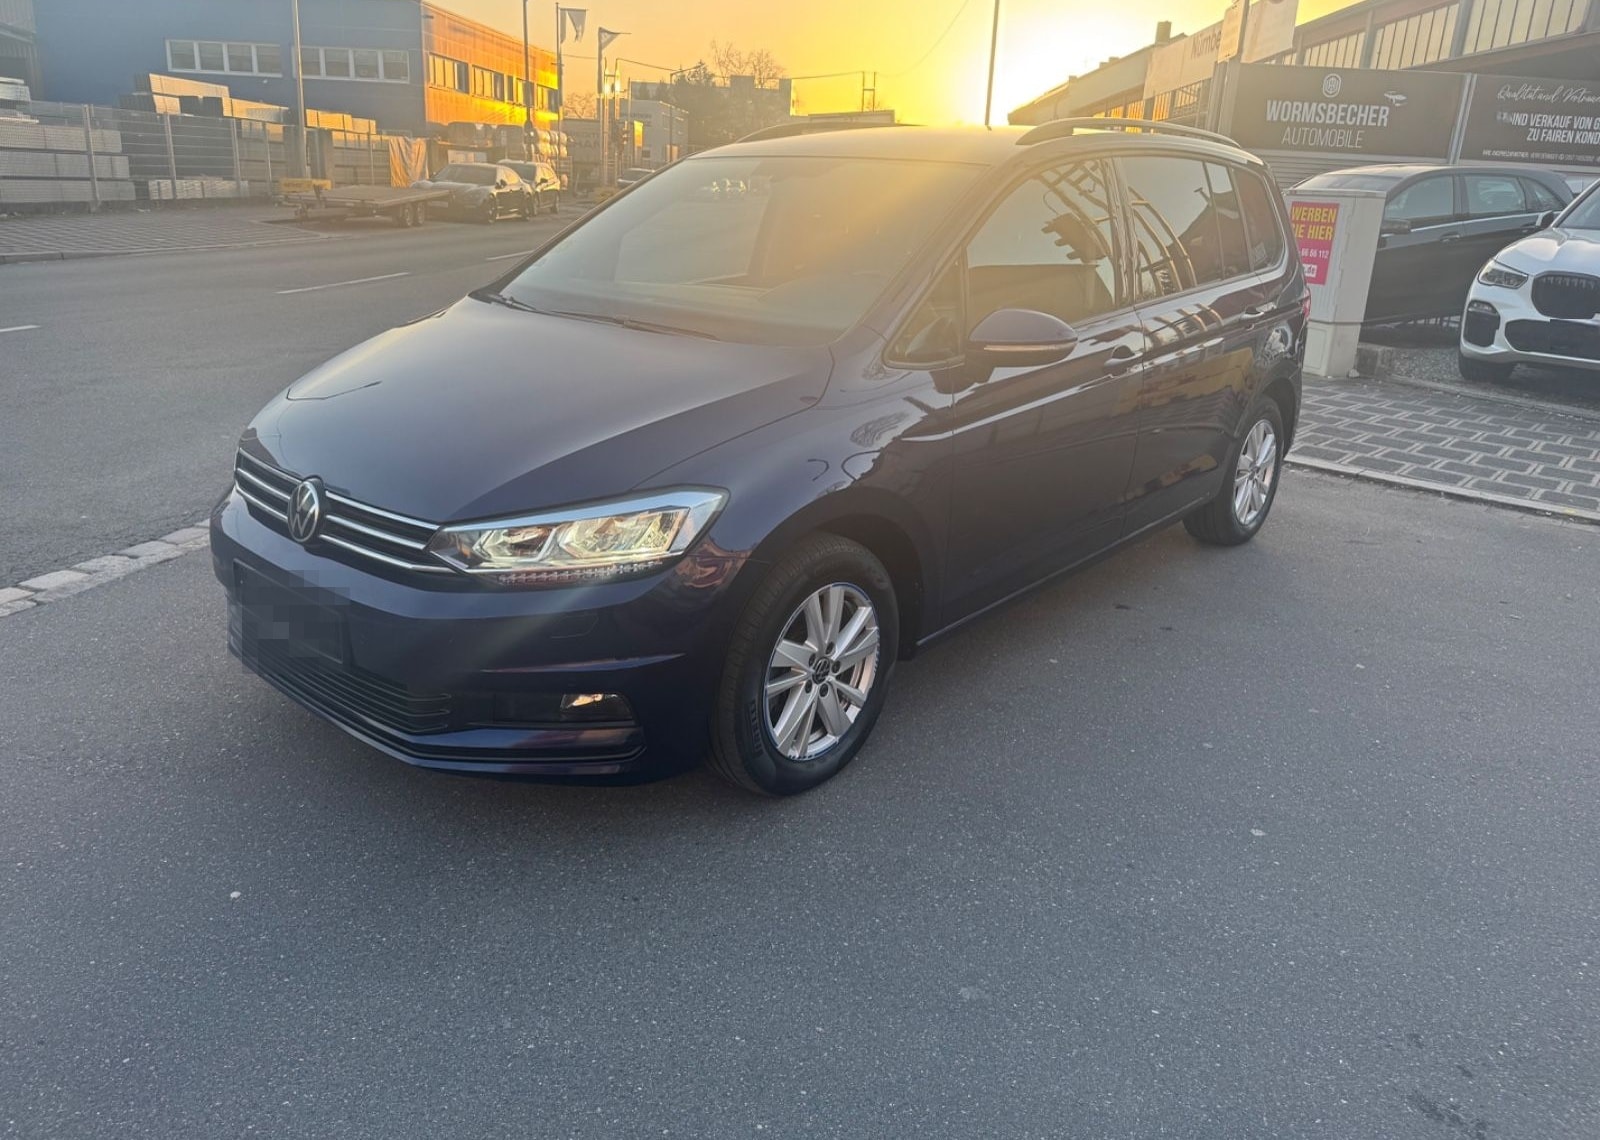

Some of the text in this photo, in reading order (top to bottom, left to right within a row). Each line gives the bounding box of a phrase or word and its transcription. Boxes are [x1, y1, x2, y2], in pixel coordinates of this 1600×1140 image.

[1266, 99, 1390, 127] WORMSBECHER
[1530, 113, 1572, 128] VERKAUF
[1573, 116, 1593, 130] VON
[1281, 126, 1366, 148] AUTOMOBILE
[1527, 128, 1540, 141] ZU
[1540, 129, 1575, 144] FAIREN
[1291, 206, 1337, 223] WERBEN
[1307, 225, 1334, 241] HIER
